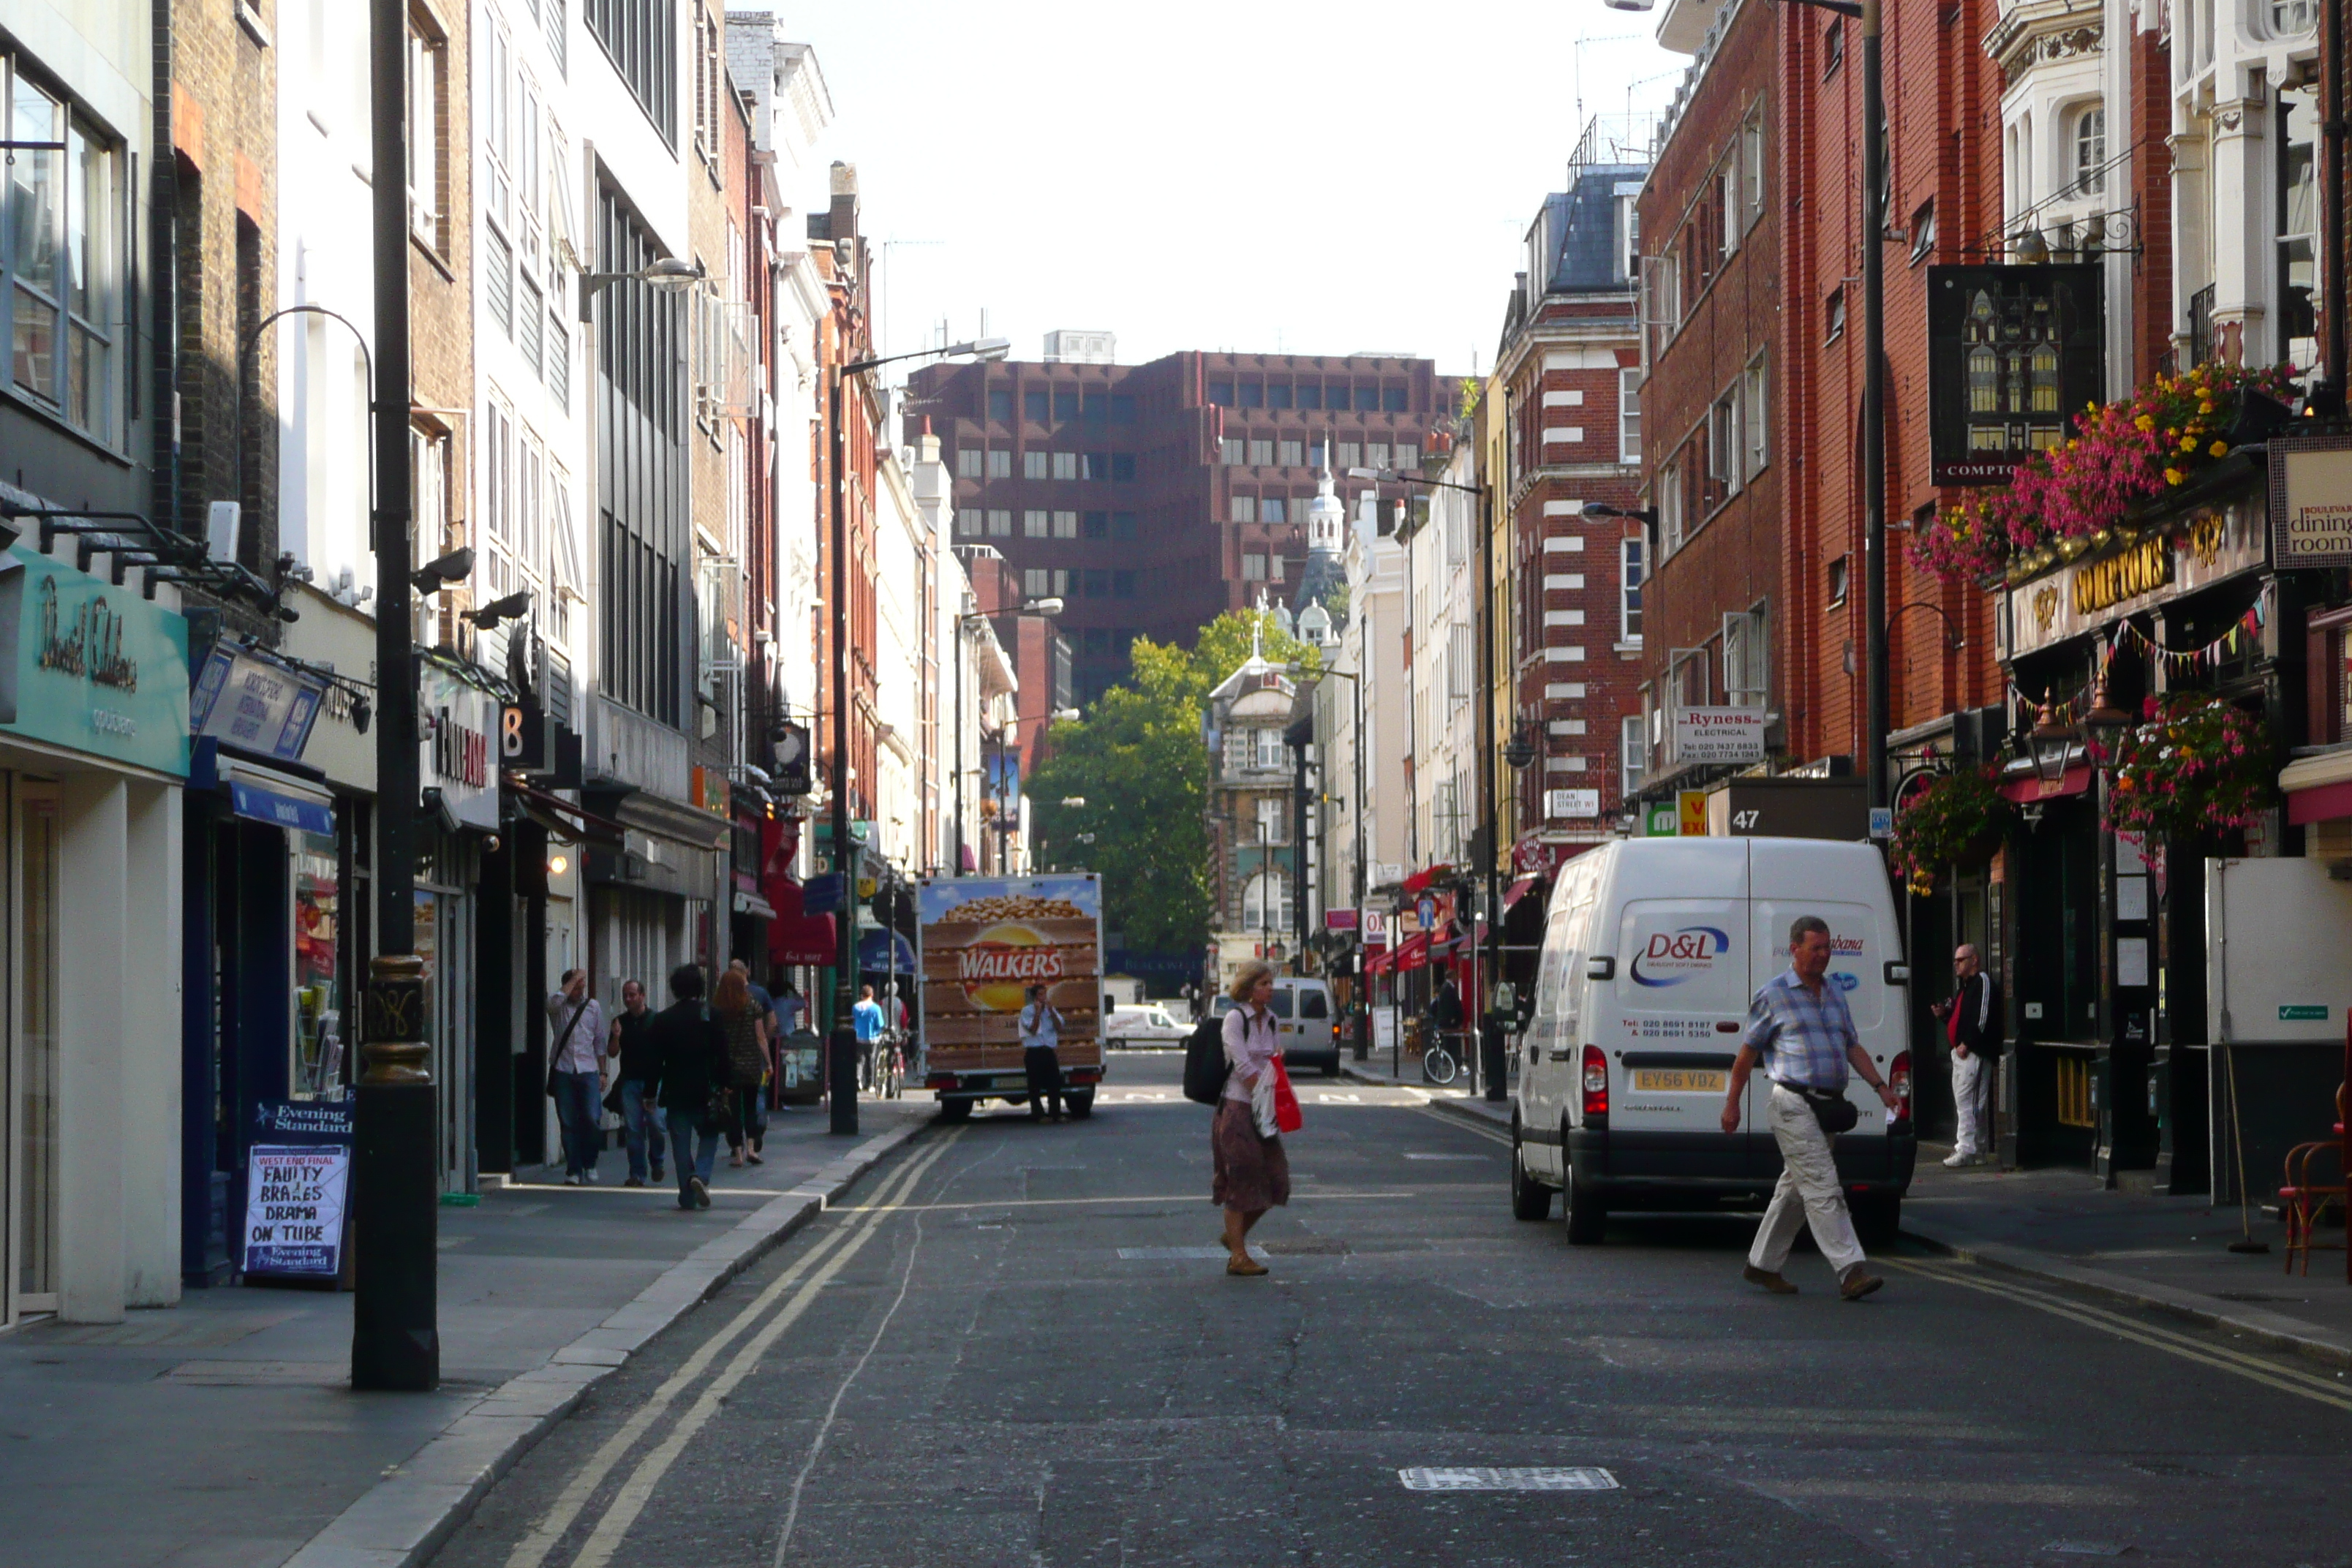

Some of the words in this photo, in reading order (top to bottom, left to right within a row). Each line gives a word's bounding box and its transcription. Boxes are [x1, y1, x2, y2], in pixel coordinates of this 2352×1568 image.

[1947, 465, 2016, 475] COMPTO
[2073, 535, 2163, 614] COMPTONS
[1689, 712, 1752, 727] Ryness
[1695, 728, 1747, 736] ELECTRICAL
[1733, 810, 1759, 829] 47
[1647, 933, 1713, 959] D&L
[960, 951, 1062, 979] WALKERS
[276, 1105, 347, 1122] Evening
[274, 1119, 353, 1134] Standard
[259, 1157, 283, 1165] WEST
[286, 1156, 306, 1165] END
[307, 1156, 334, 1164] FINAL
[265, 1206, 317, 1221] DRAMA
[252, 1226, 274, 1242] ON
[282, 1225, 324, 1241] TUBE
[273, 1246, 322, 1257] Evening
[271, 1256, 328, 1266] Standard
